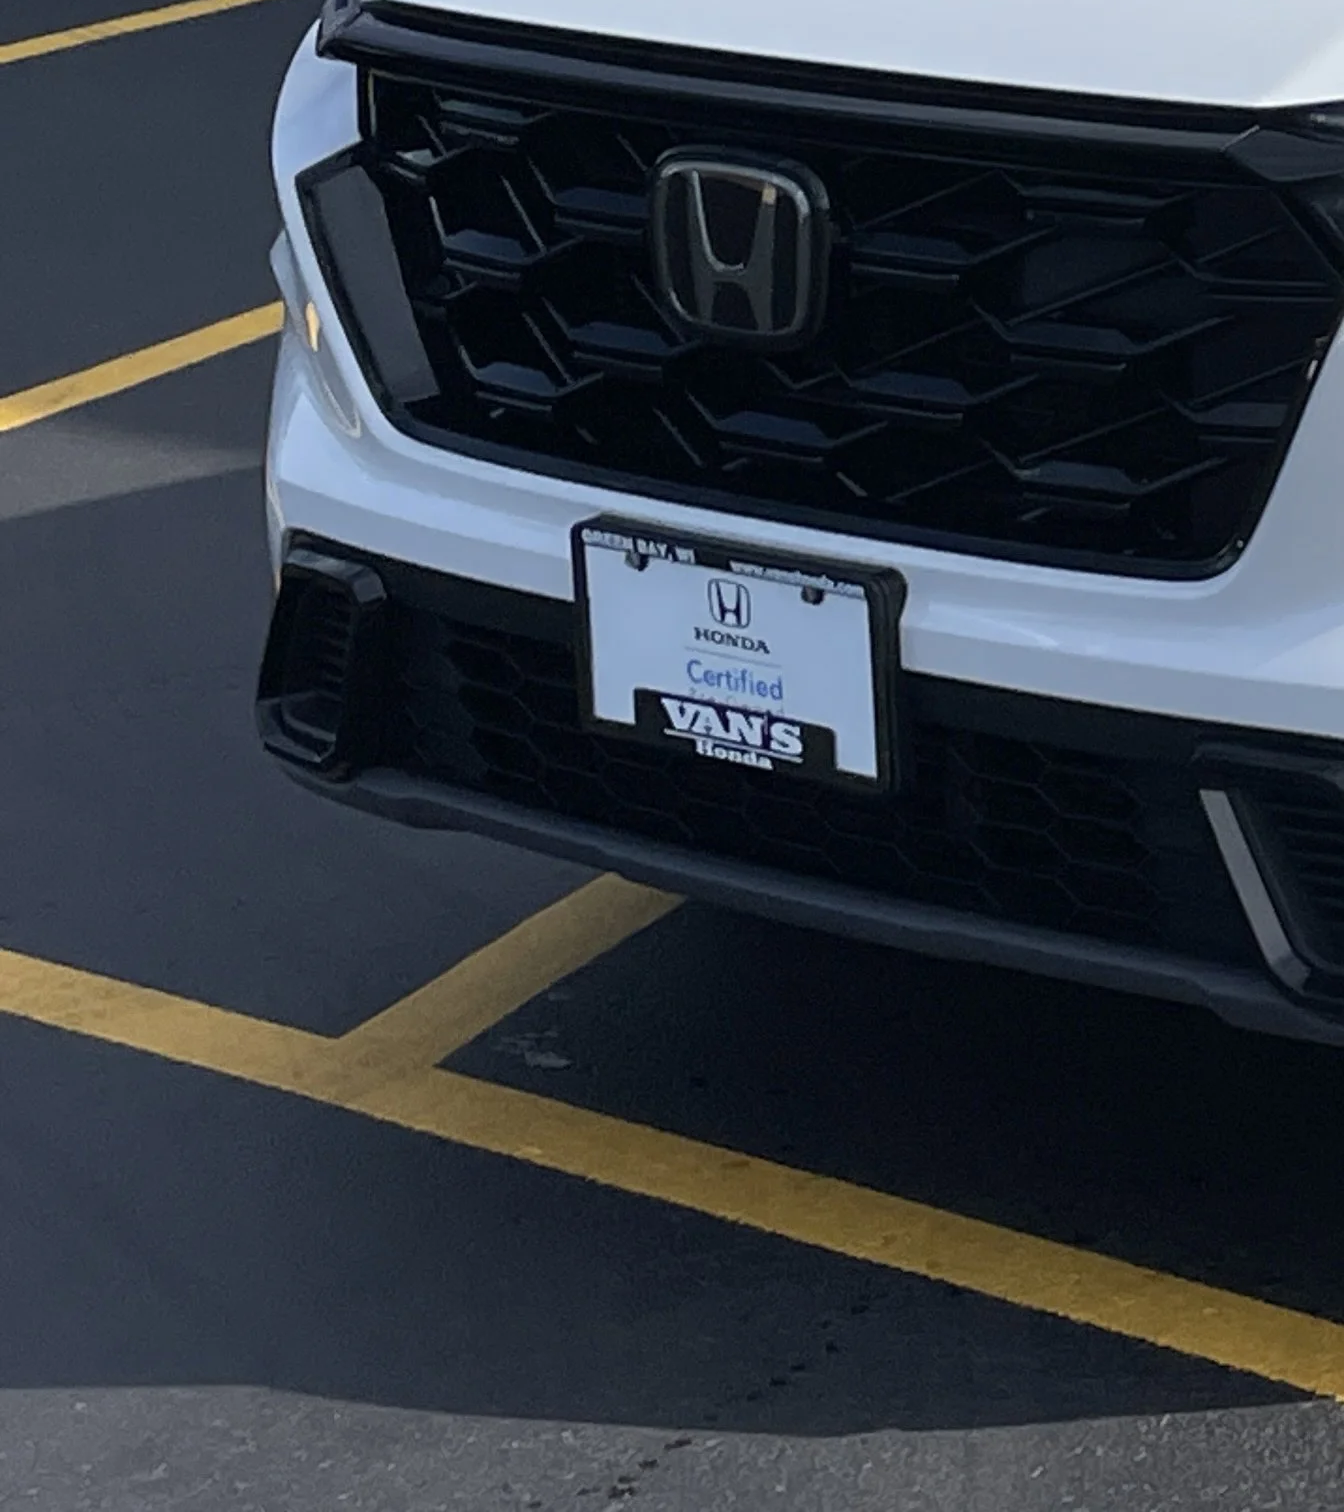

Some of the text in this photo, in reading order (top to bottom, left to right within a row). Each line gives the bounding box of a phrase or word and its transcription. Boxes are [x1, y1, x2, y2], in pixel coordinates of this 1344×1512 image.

[693, 626, 771, 655] HONDA
[686, 659, 784, 701] Certified
[660, 696, 804, 756] VAN'S
[694, 738, 775, 771] Honda
